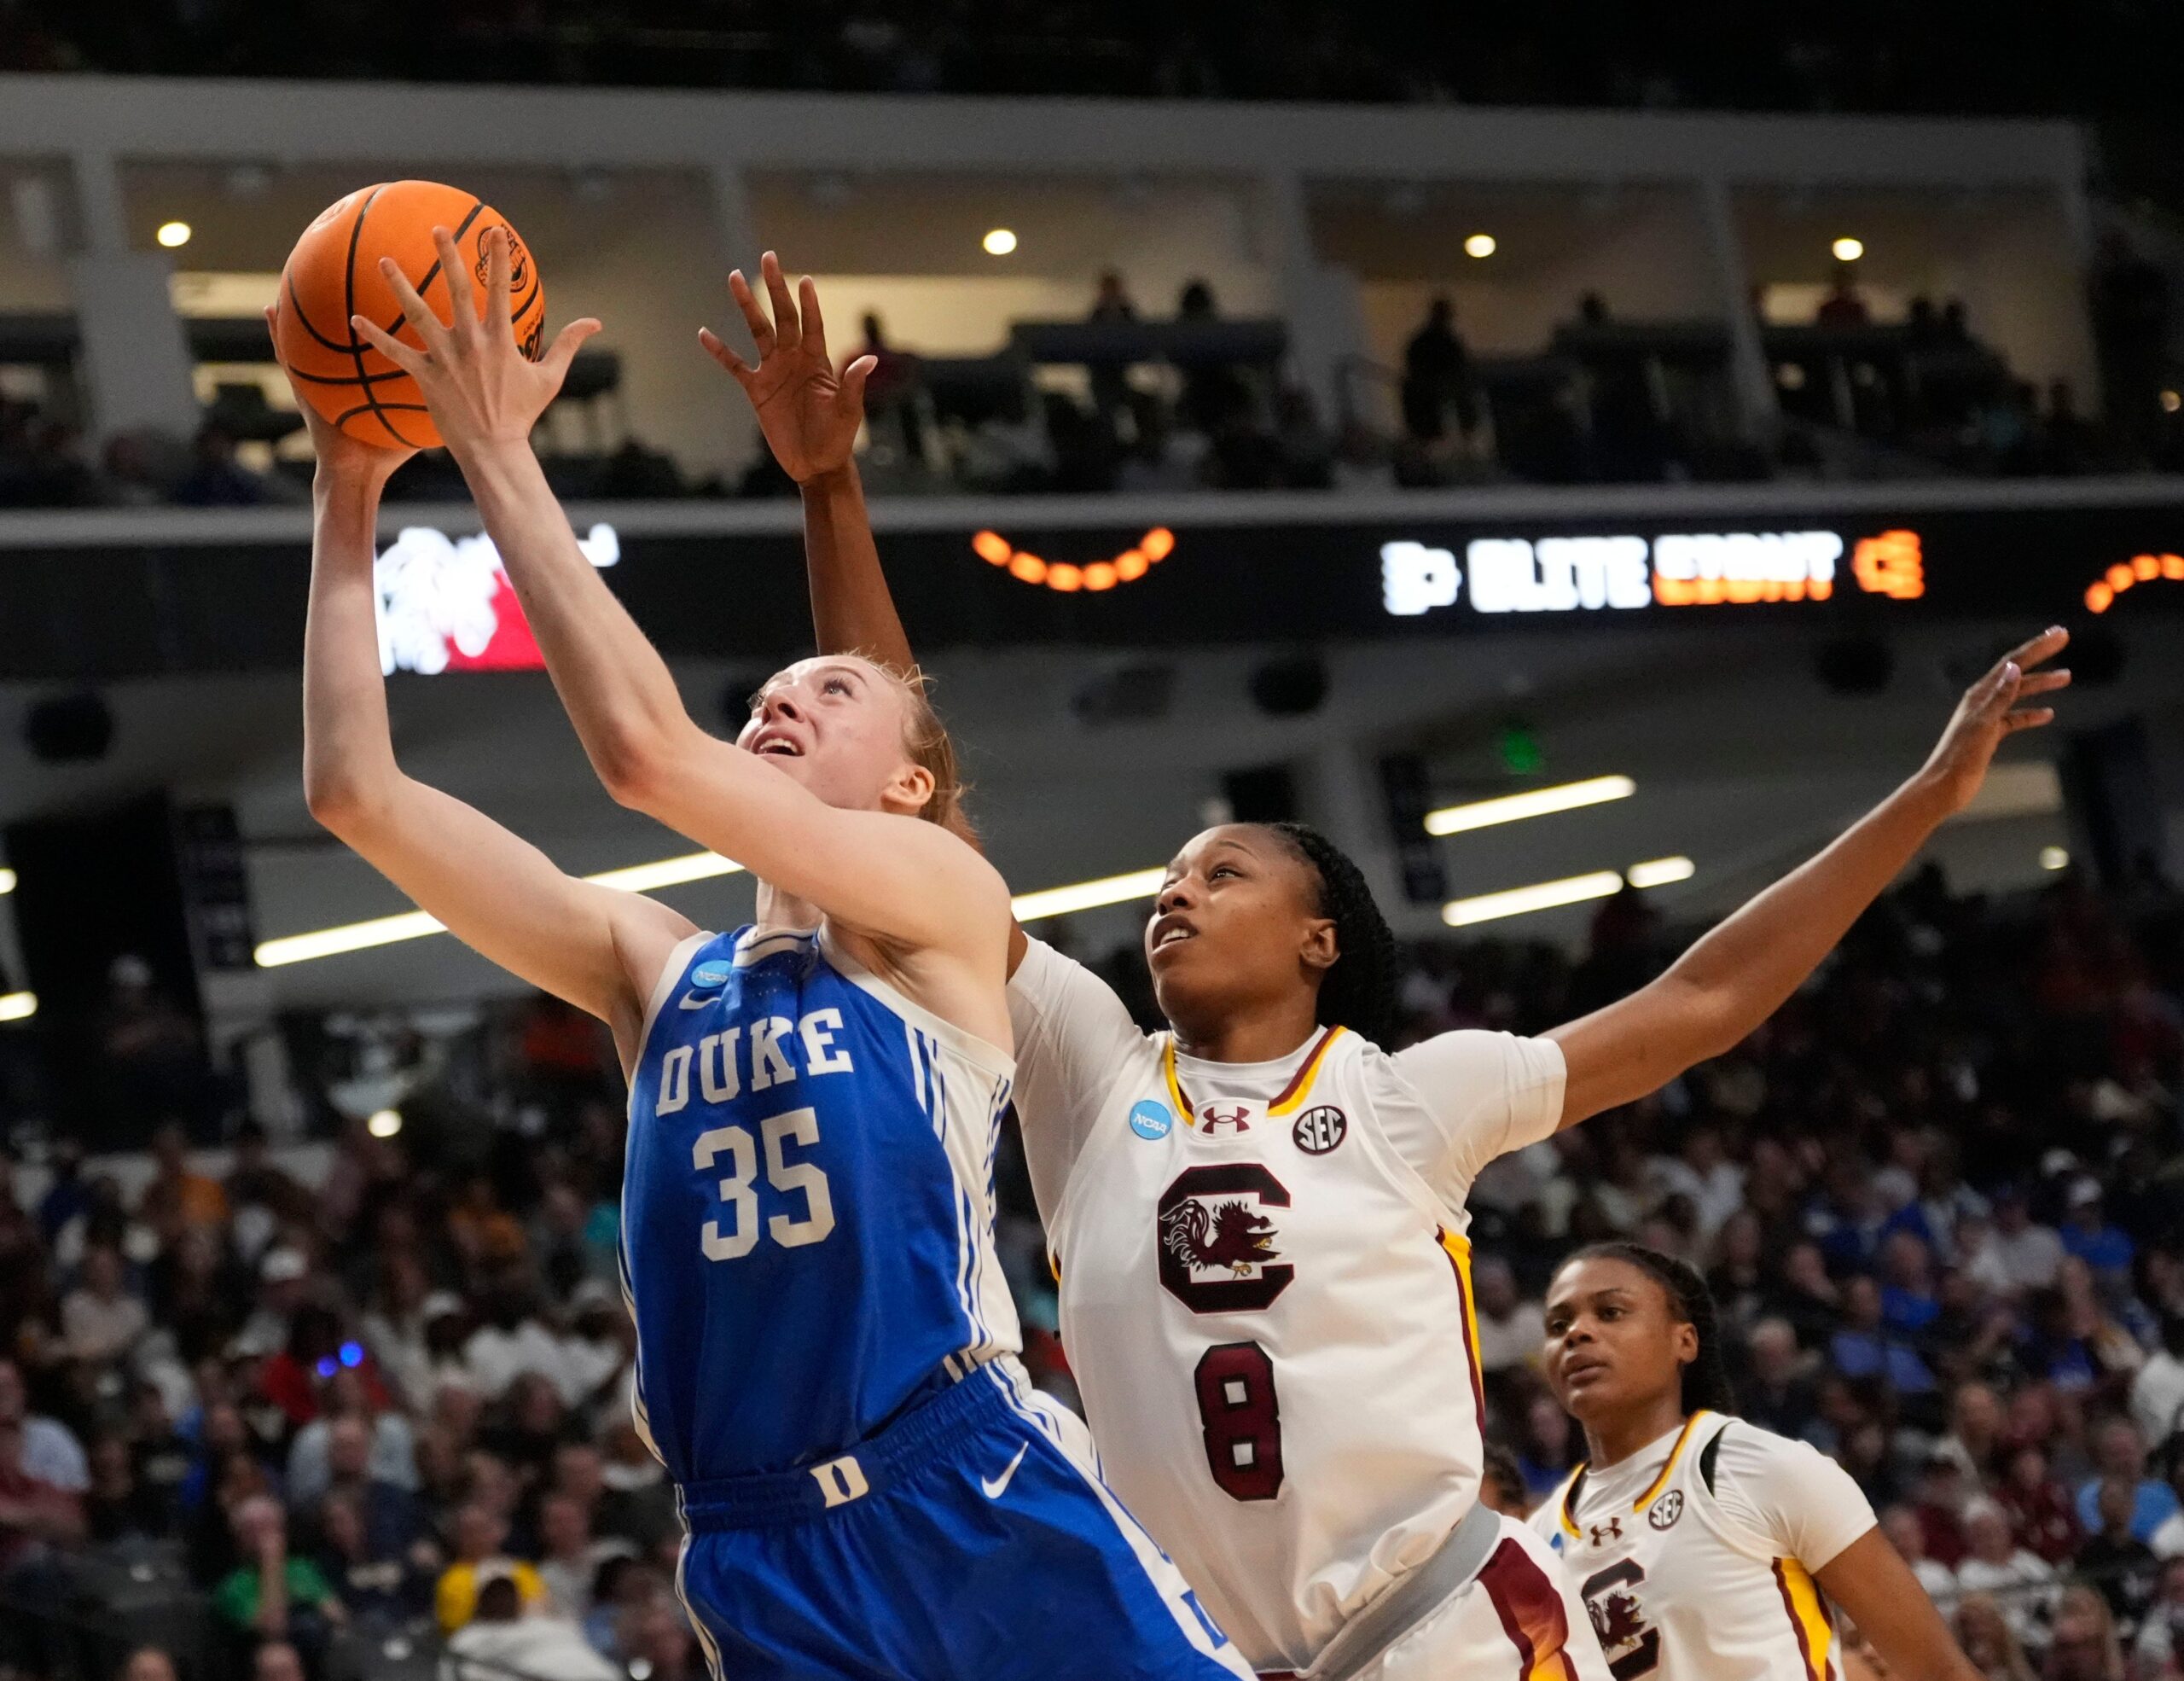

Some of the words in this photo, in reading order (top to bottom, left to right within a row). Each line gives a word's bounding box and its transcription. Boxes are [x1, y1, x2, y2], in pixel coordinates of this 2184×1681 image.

[656, 1008, 853, 1117] DUKE
[1134, 1113, 1168, 1134] NCAA
[1298, 1108, 1343, 1150] SEC
[692, 1107, 835, 1262] 35
[1194, 1341, 1285, 1502] 8
[1652, 1492, 1682, 1527] SEC
